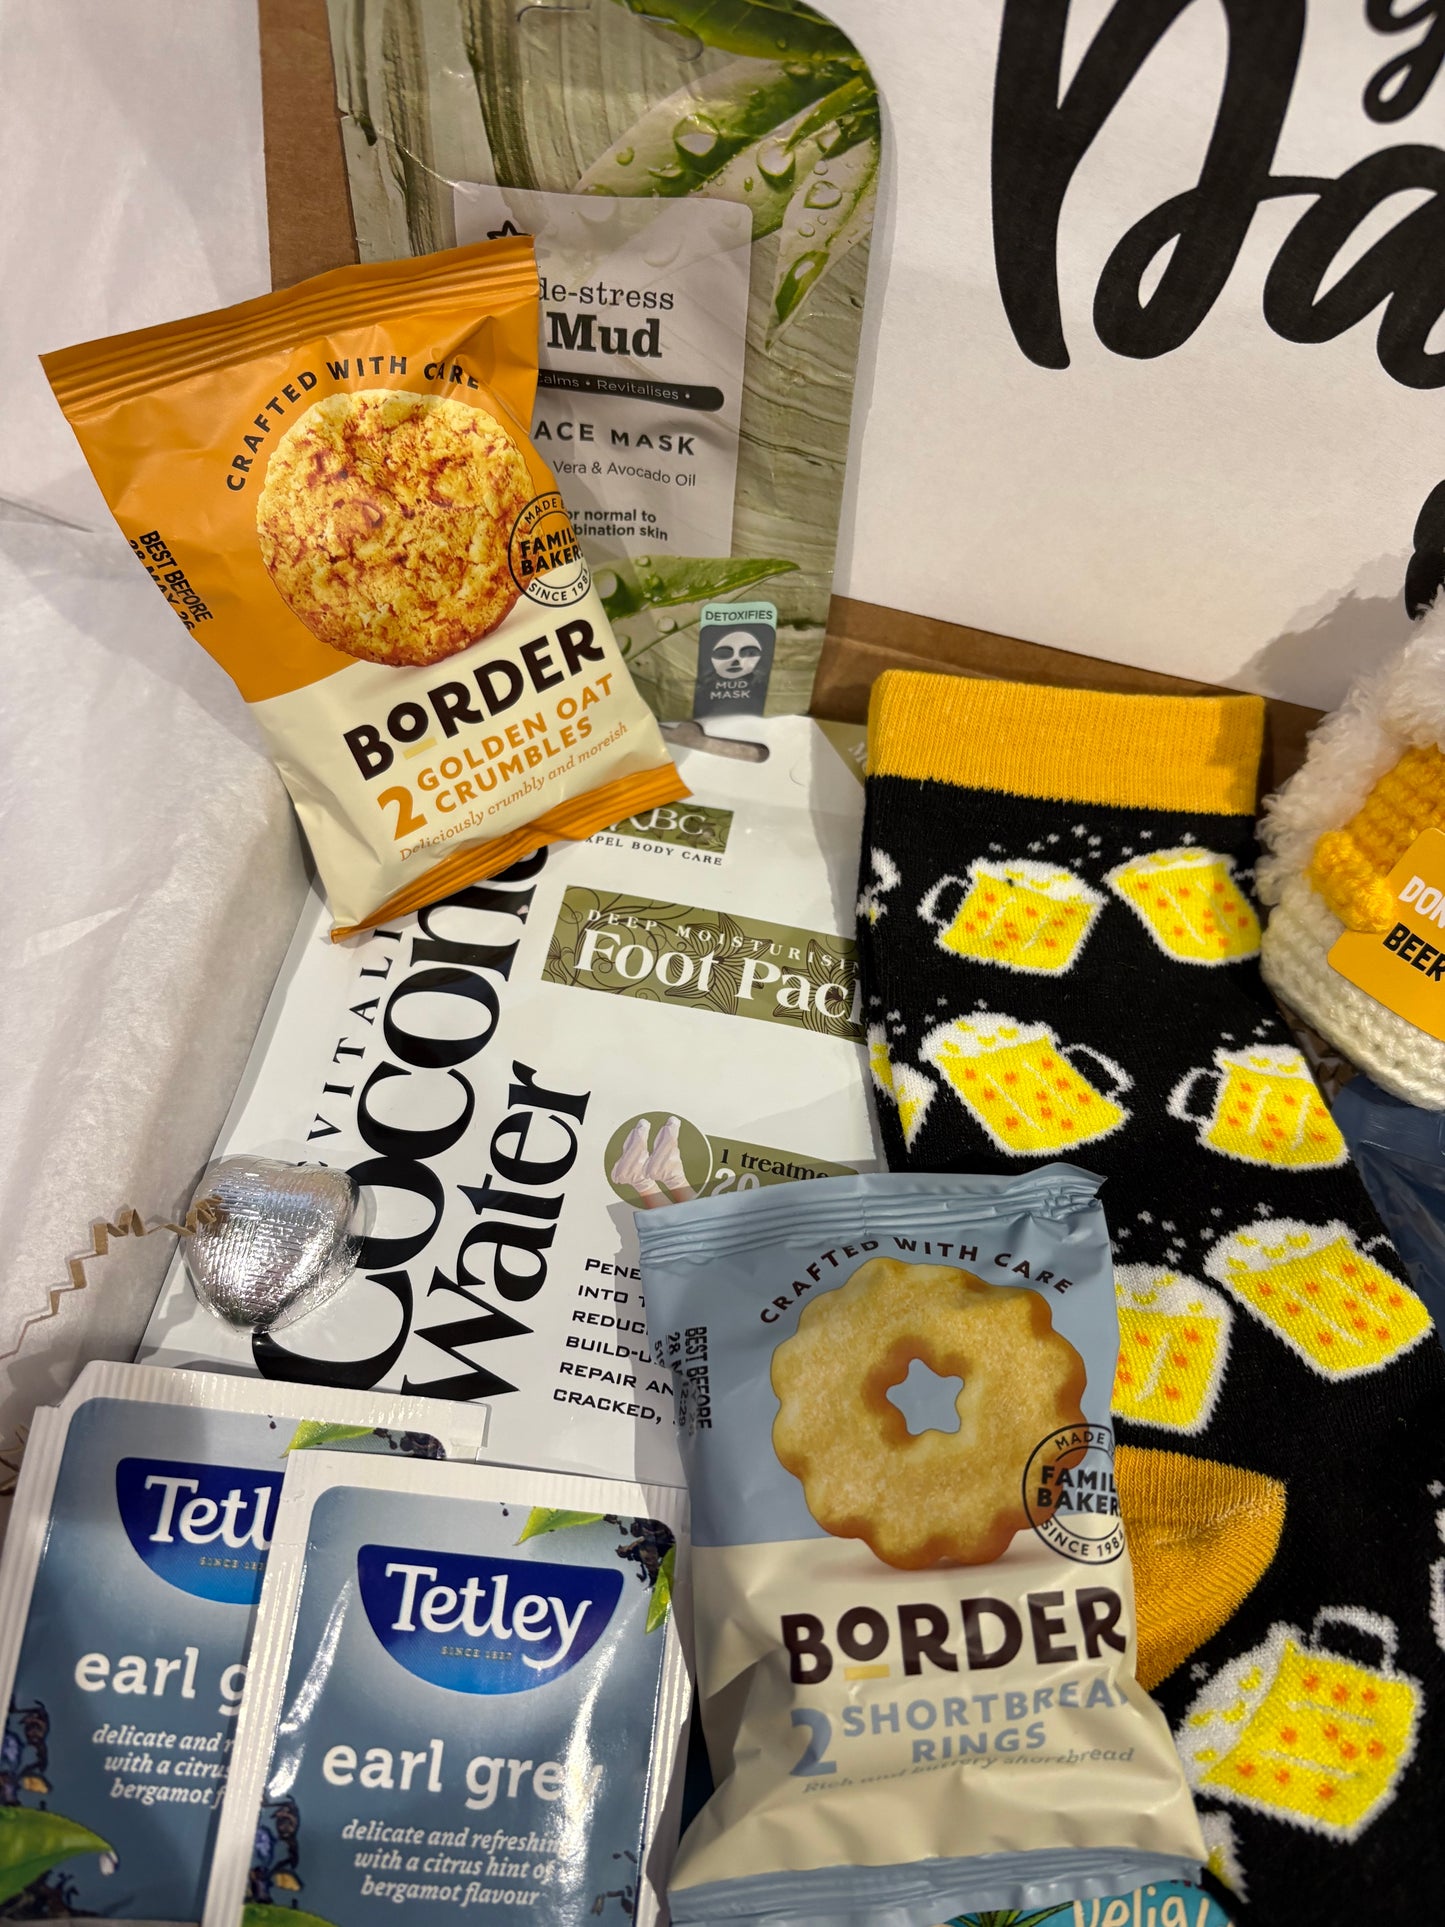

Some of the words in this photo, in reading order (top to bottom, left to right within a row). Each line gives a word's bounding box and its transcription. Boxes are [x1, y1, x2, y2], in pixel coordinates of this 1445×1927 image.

[546, 311, 663, 358] Mud
[597, 379, 679, 401] Revitalises
[226, 369, 319, 493] CRAFTED
[326, 354, 408, 382] WITH
[423, 361, 481, 391] CARE
[610, 428, 696, 456] MASK
[553, 460, 587, 475] Vera
[591, 461, 603, 475] &
[606, 463, 671, 484] Avocado
[675, 473, 697, 488] Oil
[524, 497, 558, 525] MADE
[584, 508, 637, 523] normal
[641, 509, 657, 523] to
[639, 524, 669, 542] skin
[139, 530, 178, 570] BEST
[164, 569, 214, 623] BEFORE
[528, 582, 568, 602] SINCE
[704, 607, 774, 624] DETOXIFIES
[342, 618, 606, 781] BORDER
[709, 688, 751, 701] MASK
[715, 679, 748, 690] MUD
[376, 785, 429, 841] 2
[416, 711, 548, 793] GOLDEN
[556, 673, 614, 721] OAT
[434, 714, 594, 814] CRUMBLES
[400, 809, 485, 862] Deliciously
[487, 777, 546, 817] crumbly
[548, 758, 577, 781] and
[578, 721, 629, 765] moreish
[631, 841, 675, 857] BODY
[681, 851, 723, 866] CARE
[588, 909, 660, 932] DEEP
[573, 927, 723, 994] Foot
[401, 1059, 591, 1401] Water
[578, 1284, 629, 1304] INTO
[759, 1239, 880, 1326] CRAFTED
[893, 1235, 979, 1262] WITH
[993, 1252, 1074, 1295] CARE
[571, 1310, 649, 1336] REDUC
[685, 1326, 708, 1363] BEST
[559, 1361, 638, 1389] REPAIR
[553, 1388, 662, 1425] CRACKED,
[687, 1365, 713, 1429] BEFORE
[1054, 1430, 1106, 1451] MADE
[1040, 1519, 1090, 1557] SINCE
[385, 1562, 593, 1671] Tetley
[780, 1586, 1127, 1685] BORDER
[74, 1646, 198, 1700] earl
[92, 1723, 177, 1752] delicate
[179, 1732, 223, 1752] and
[788, 1708, 838, 1777] 2
[911, 1721, 1047, 1764] RINGS
[104, 1752, 154, 1775] with
[156, 1759, 171, 1776] a
[322, 1738, 444, 1793] earl
[110, 1777, 213, 1806] bergamot
[802, 1777, 853, 1794] Rich
[341, 1819, 425, 1847] delicate
[427, 1827, 468, 1849] and
[354, 1850, 403, 1873] with
[407, 1857, 419, 1873] a
[423, 1852, 482, 1877] citrus
[485, 1855, 529, 1879] hint
[360, 1874, 464, 1905] bergamot
[460, 1879, 545, 1907] flavour
